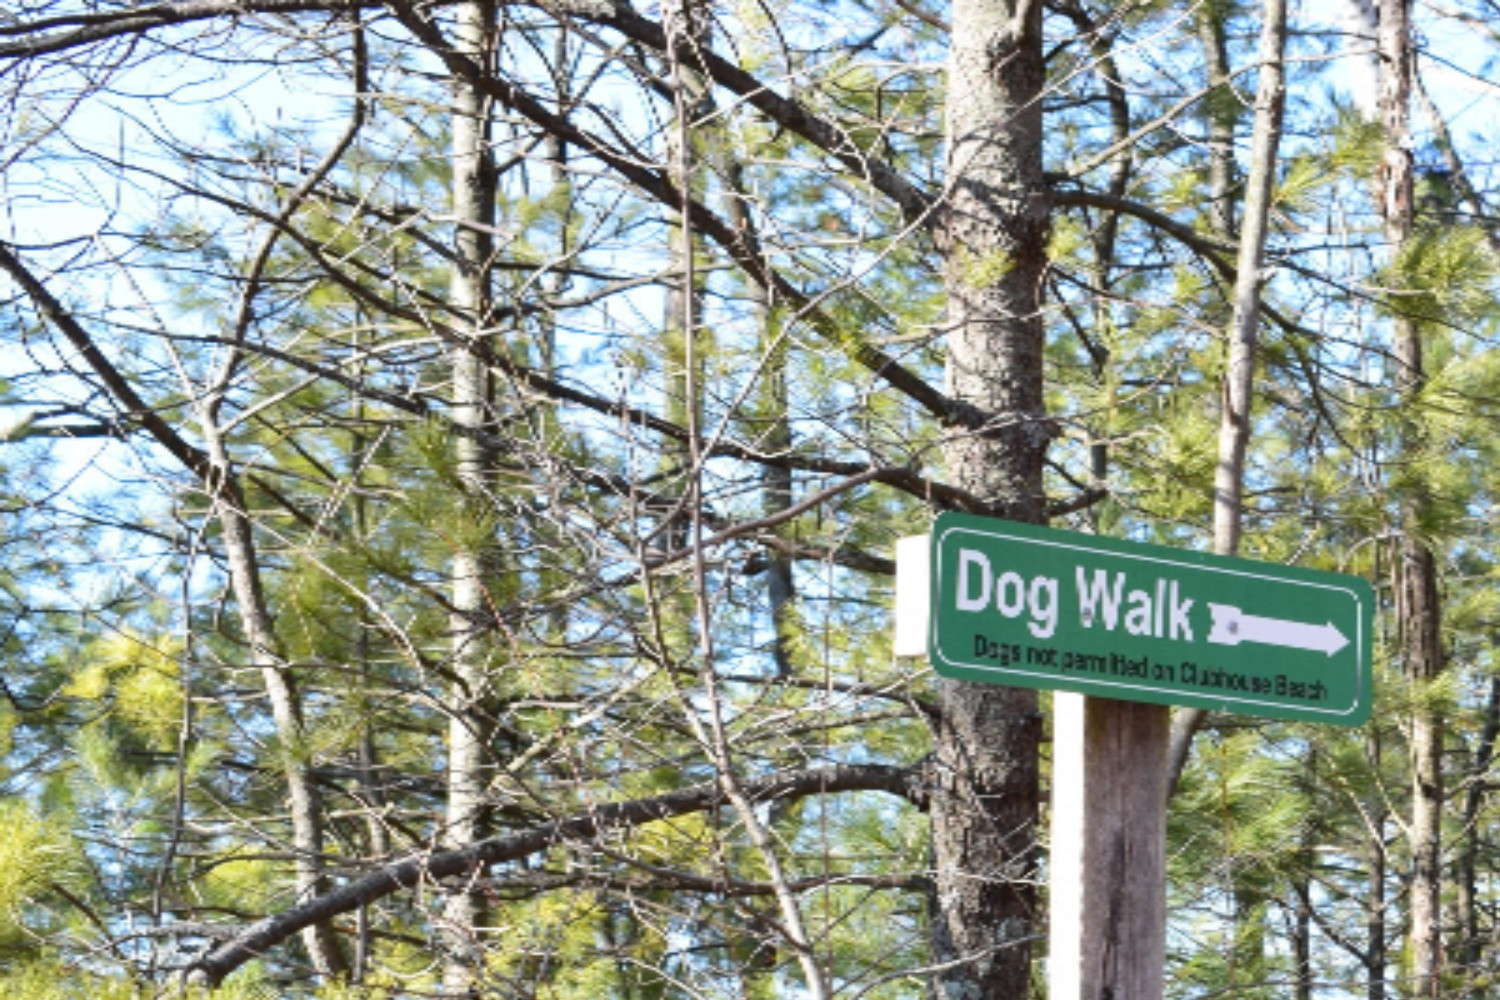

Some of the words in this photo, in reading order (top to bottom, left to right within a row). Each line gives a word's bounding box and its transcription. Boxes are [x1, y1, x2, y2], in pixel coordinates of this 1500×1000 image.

[955, 548, 1059, 638] Dog
[1075, 565, 1195, 642] Walk
[974, 634, 1021, 666] Dogs
[1027, 645, 1058, 668] not
[1062, 649, 1148, 679] permitted
[1153, 662, 1175, 682] on
[1180, 662, 1271, 695] Clubhouse
[1275, 675, 1329, 701] Beach
